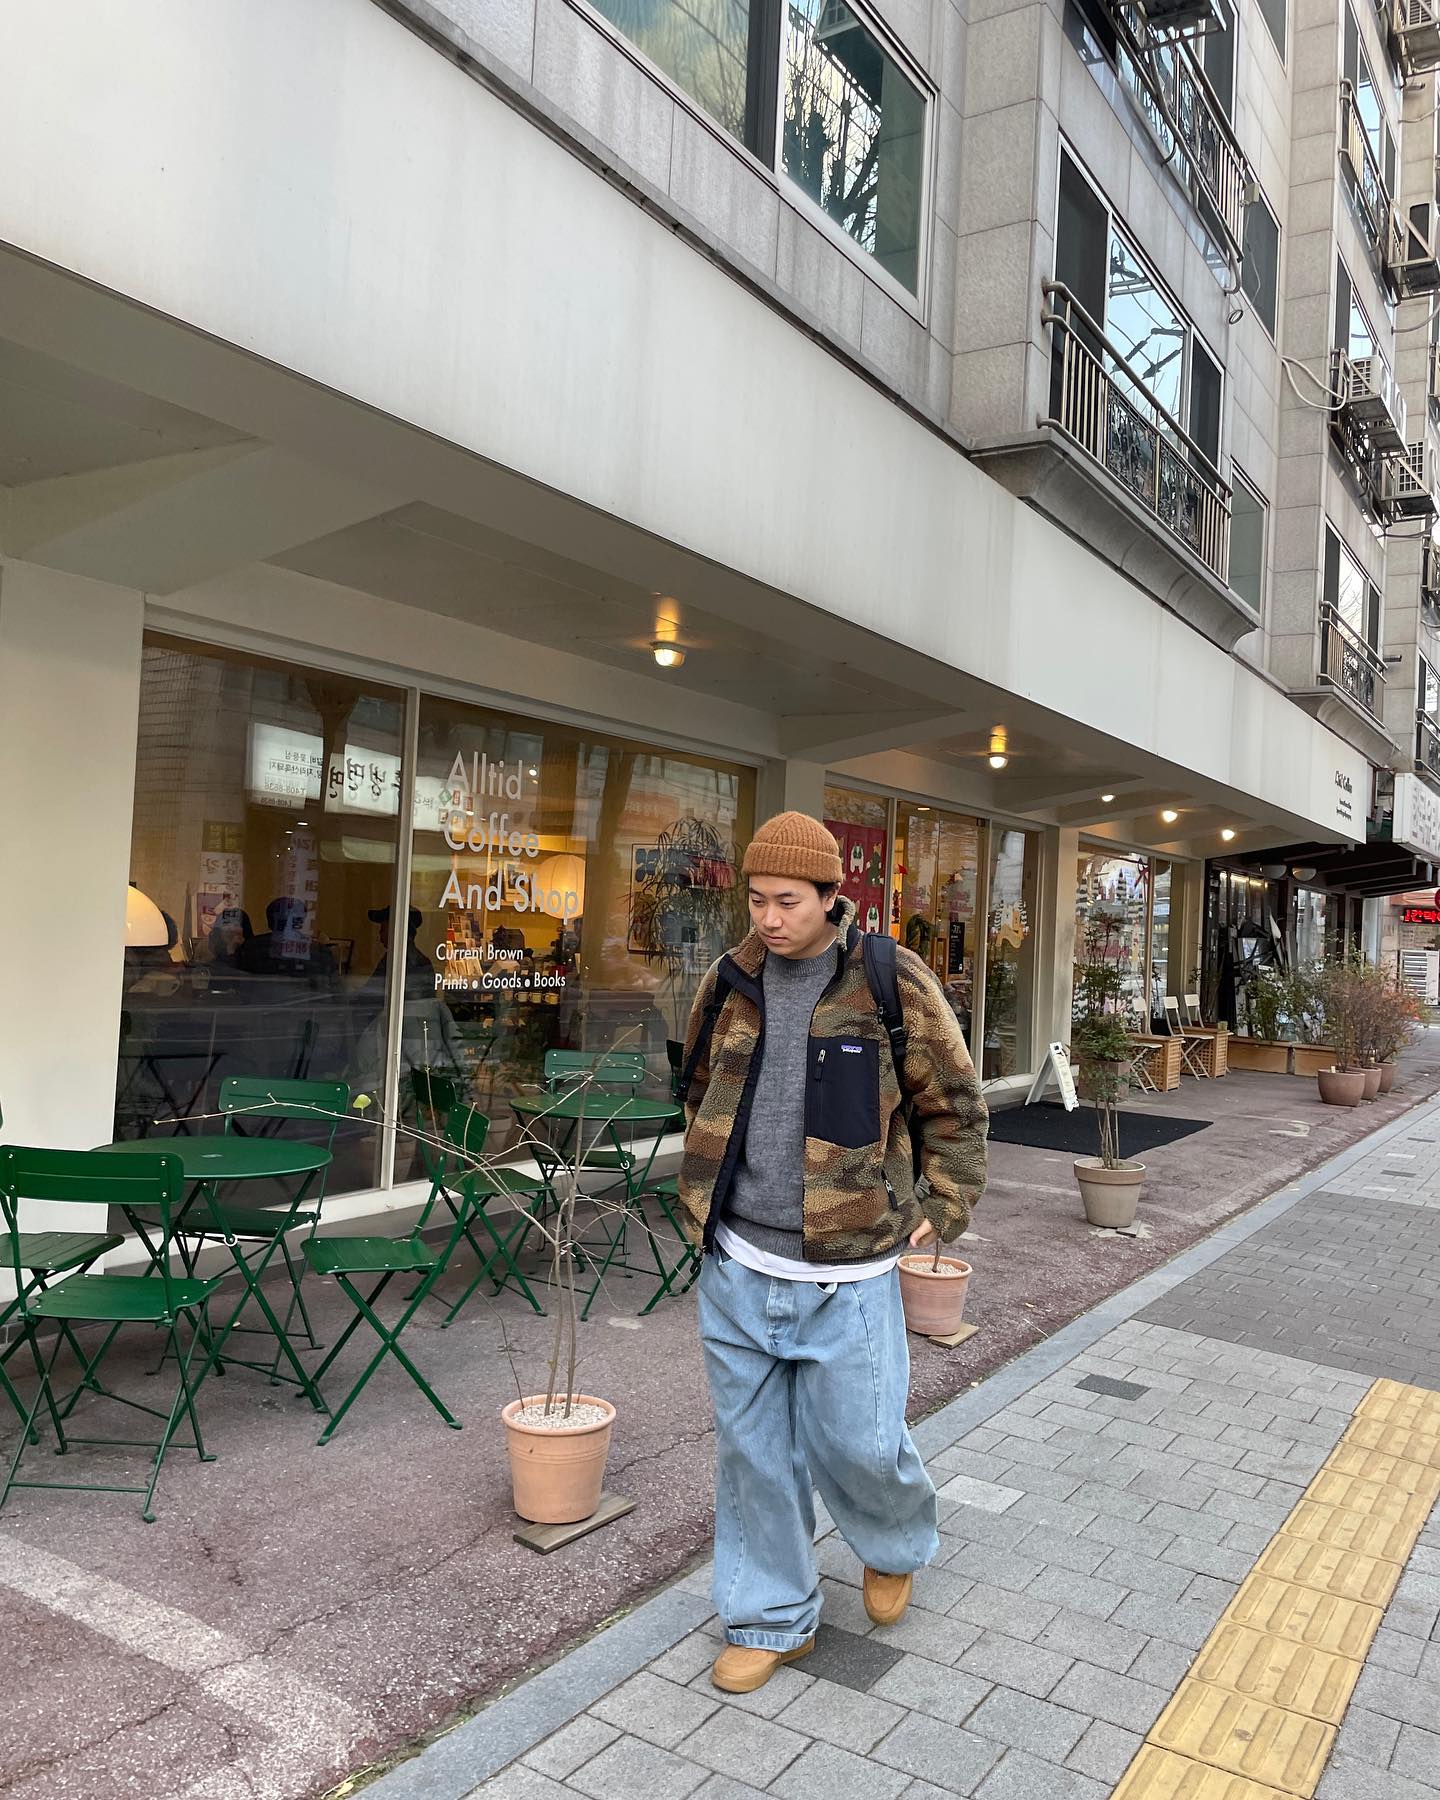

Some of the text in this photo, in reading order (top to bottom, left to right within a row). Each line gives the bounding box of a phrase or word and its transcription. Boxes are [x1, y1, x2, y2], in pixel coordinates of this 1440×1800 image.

[447, 750, 523, 800] Alltid
[444, 812, 540, 858] Coffee
[439, 868, 579, 925] And Shop
[436, 943, 524, 961] Current Brown
[434, 970, 566, 991] Prints Goods Books
